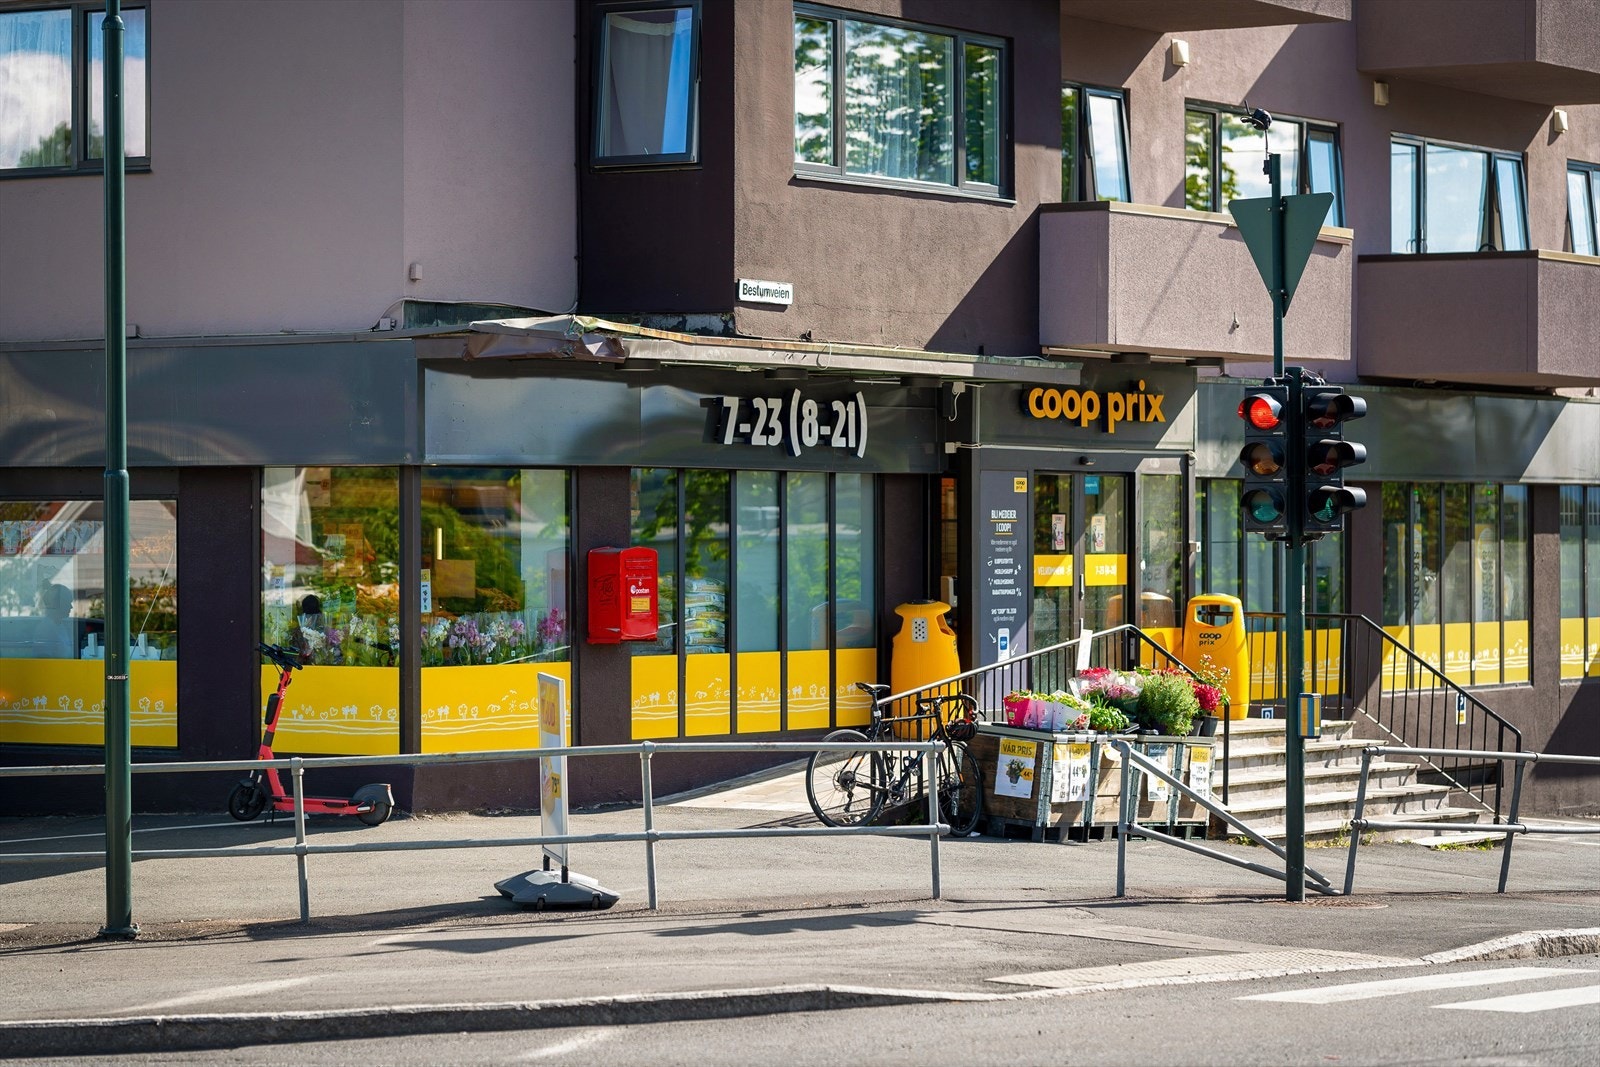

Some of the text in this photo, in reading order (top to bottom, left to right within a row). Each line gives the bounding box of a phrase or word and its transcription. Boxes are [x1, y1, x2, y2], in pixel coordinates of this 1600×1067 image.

[742, 283, 789, 299] Bestumveien
[1028, 379, 1166, 434] coop prix
[723, 388, 868, 459] 7-23 (8-21)
[999, 523, 1012, 532] COOP!
[1199, 632, 1221, 640] coop
[1002, 742, 1032, 756] VÅR PRIS
